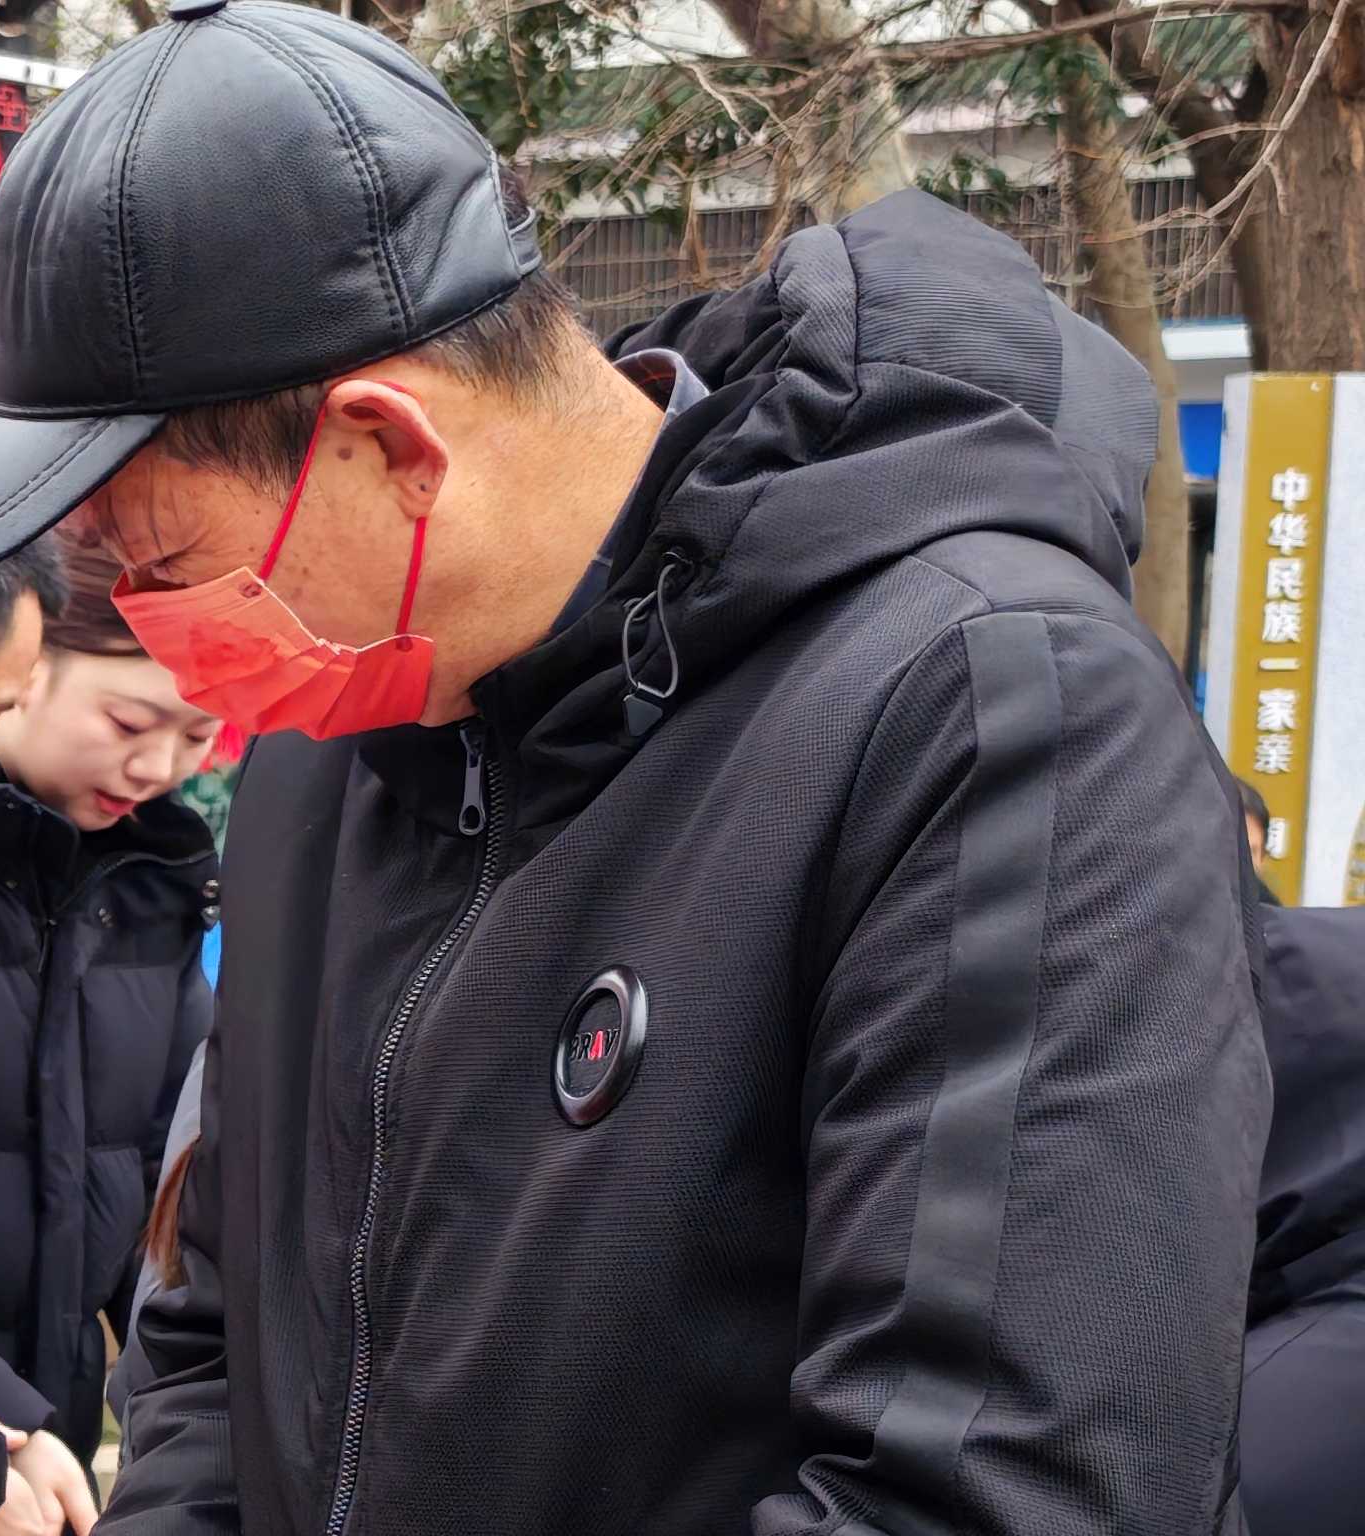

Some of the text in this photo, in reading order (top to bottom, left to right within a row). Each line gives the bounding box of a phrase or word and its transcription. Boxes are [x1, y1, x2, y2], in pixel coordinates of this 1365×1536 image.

[1253, 466, 1311, 775] 中华民族一家亲
